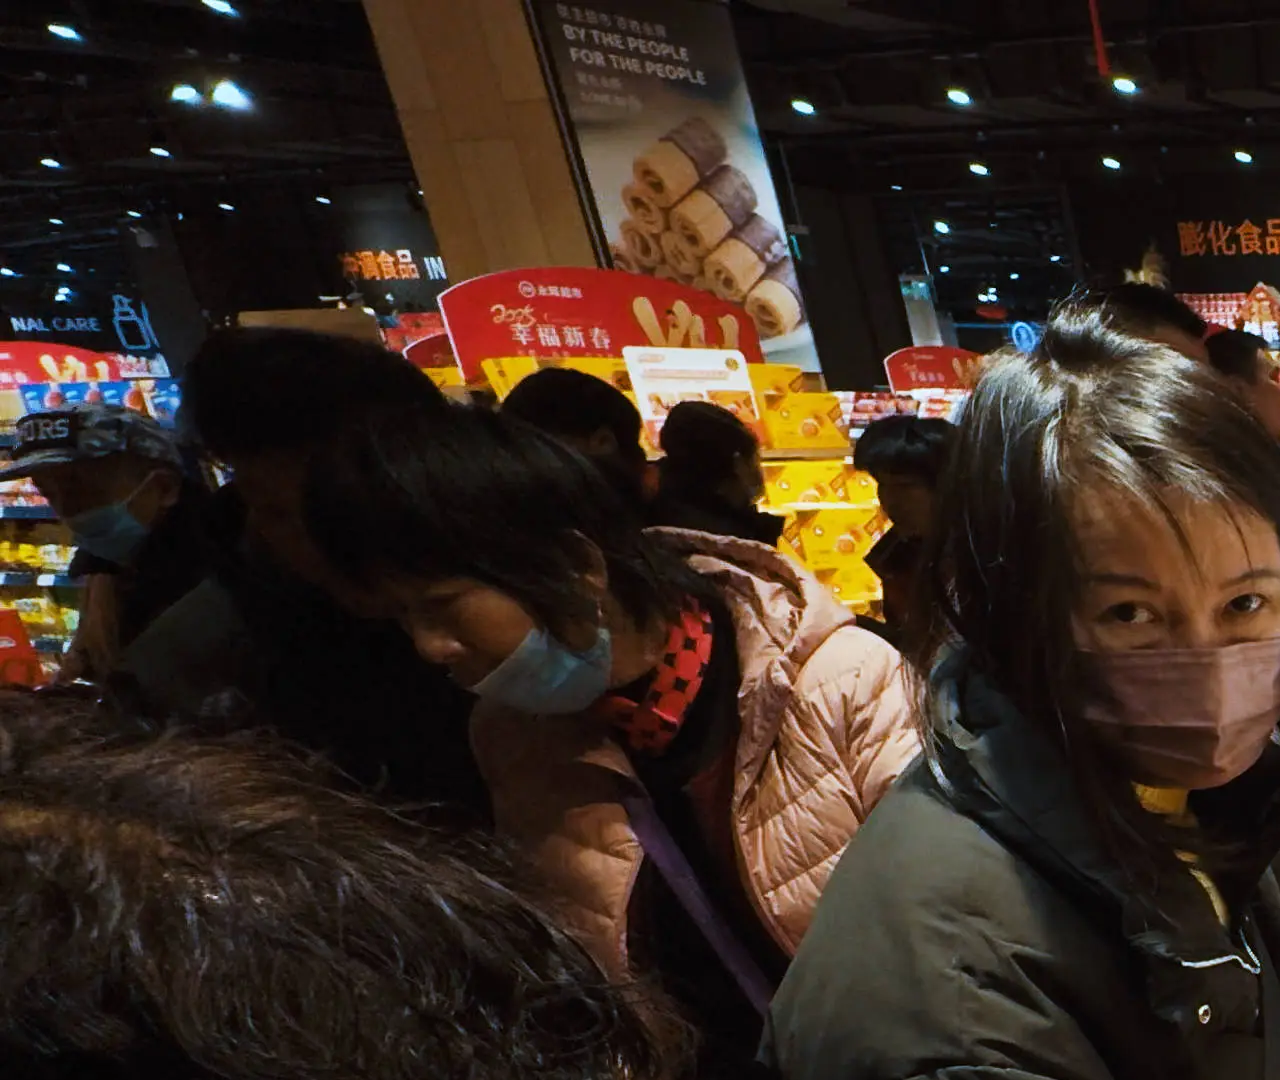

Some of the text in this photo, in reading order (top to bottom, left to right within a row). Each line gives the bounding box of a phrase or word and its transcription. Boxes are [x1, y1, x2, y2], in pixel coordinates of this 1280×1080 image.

[562, 24, 689, 62] BY THE PEOPLE
[569, 47, 606, 68] FOR
[608, 54, 642, 74] THE
[644, 61, 707, 85] PEOPLE
[423, 256, 447, 280] IN
[52, 317, 101, 332] CARE
[510, 322, 612, 350] 幸福新春
